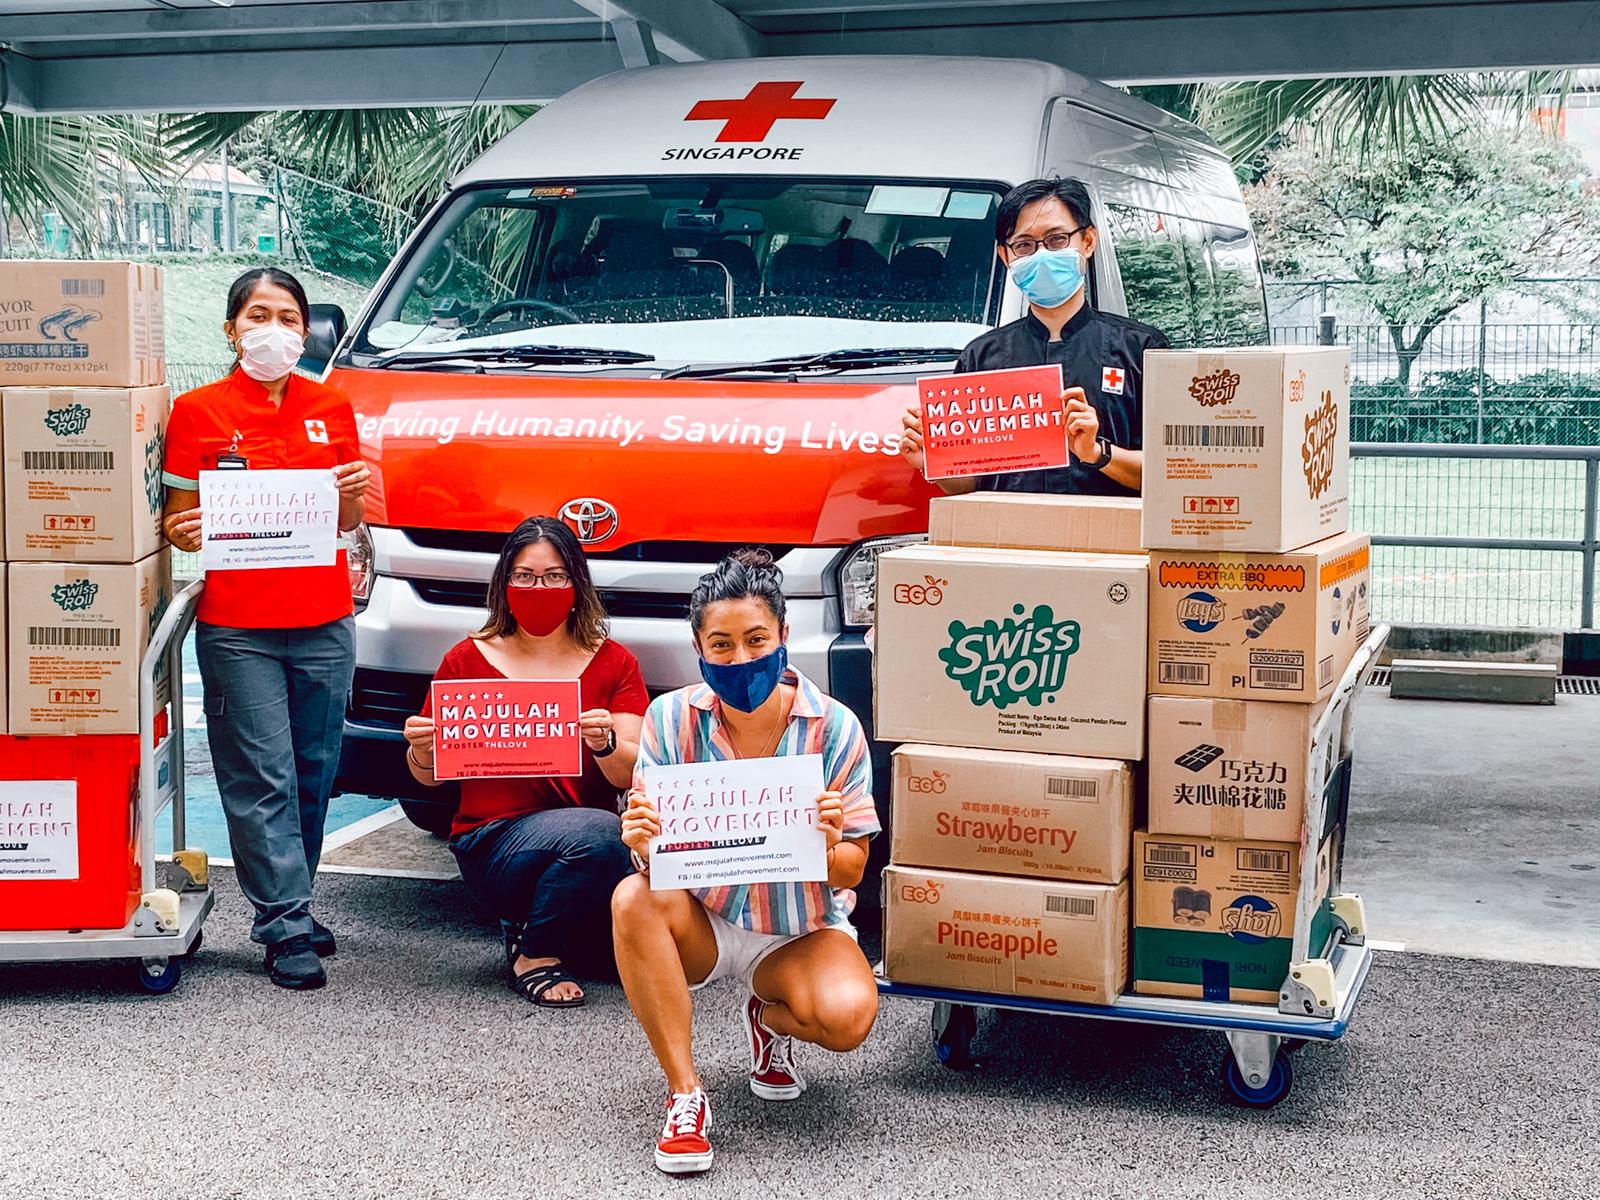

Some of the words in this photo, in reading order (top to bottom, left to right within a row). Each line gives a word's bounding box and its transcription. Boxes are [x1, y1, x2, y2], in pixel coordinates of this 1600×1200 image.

[661, 148, 804, 160] SINGAPORE
[0, 300, 34, 315] VOR
[926, 392, 1043, 419] MAJULAH
[929, 410, 1062, 438] MOVEMENT
[469, 410, 644, 447] Humanity,
[659, 415, 786, 455] Saving
[801, 420, 901, 456] Lives
[930, 434, 1014, 449] #FOSTERTHELOVE
[953, 453, 1040, 467] www.majulahmovement.com
[210, 493, 316, 508] MAJULAH
[210, 511, 332, 527] MOVEMENT
[1197, 571, 1235, 582] EXTRA
[1240, 573, 1265, 584] BBQ
[894, 584, 943, 606] EGO
[952, 623, 1075, 675] Swiss
[1253, 655, 1301, 664] 320021627
[440, 703, 559, 721] MAJULAH
[441, 722, 577, 741] MOVEMENT
[998, 720, 1016, 728] Packing
[442, 741, 528, 750] #FOSTERTHELOVE
[464, 760, 553, 768] www.majulahmovement.com
[1219, 760, 1287, 784] 巧克力
[908, 777, 946, 794] EGO
[658, 786, 794, 813] MAJULAH
[1173, 783, 1287, 810] 夹心棉花糖
[0, 803, 52, 817] LAH
[658, 808, 817, 836] MOVEMENT
[936, 811, 1077, 854] Strawberry
[661, 837, 761, 851] #FOSTERTHELOVE
[976, 844, 997, 854] Jam
[998, 845, 1034, 858] Biscuits
[684, 852, 793, 868] www.majulahmovement.com
[706, 866, 800, 879] @majulahmovement.com
[902, 885, 940, 904] EGO
[938, 921, 1058, 960] Pineapple
[945, 951, 965, 962] Jam
[967, 952, 1002, 965] Biscuits
[1167, 956, 1203, 968] WEED
[1236, 962, 1266, 974] NORI
